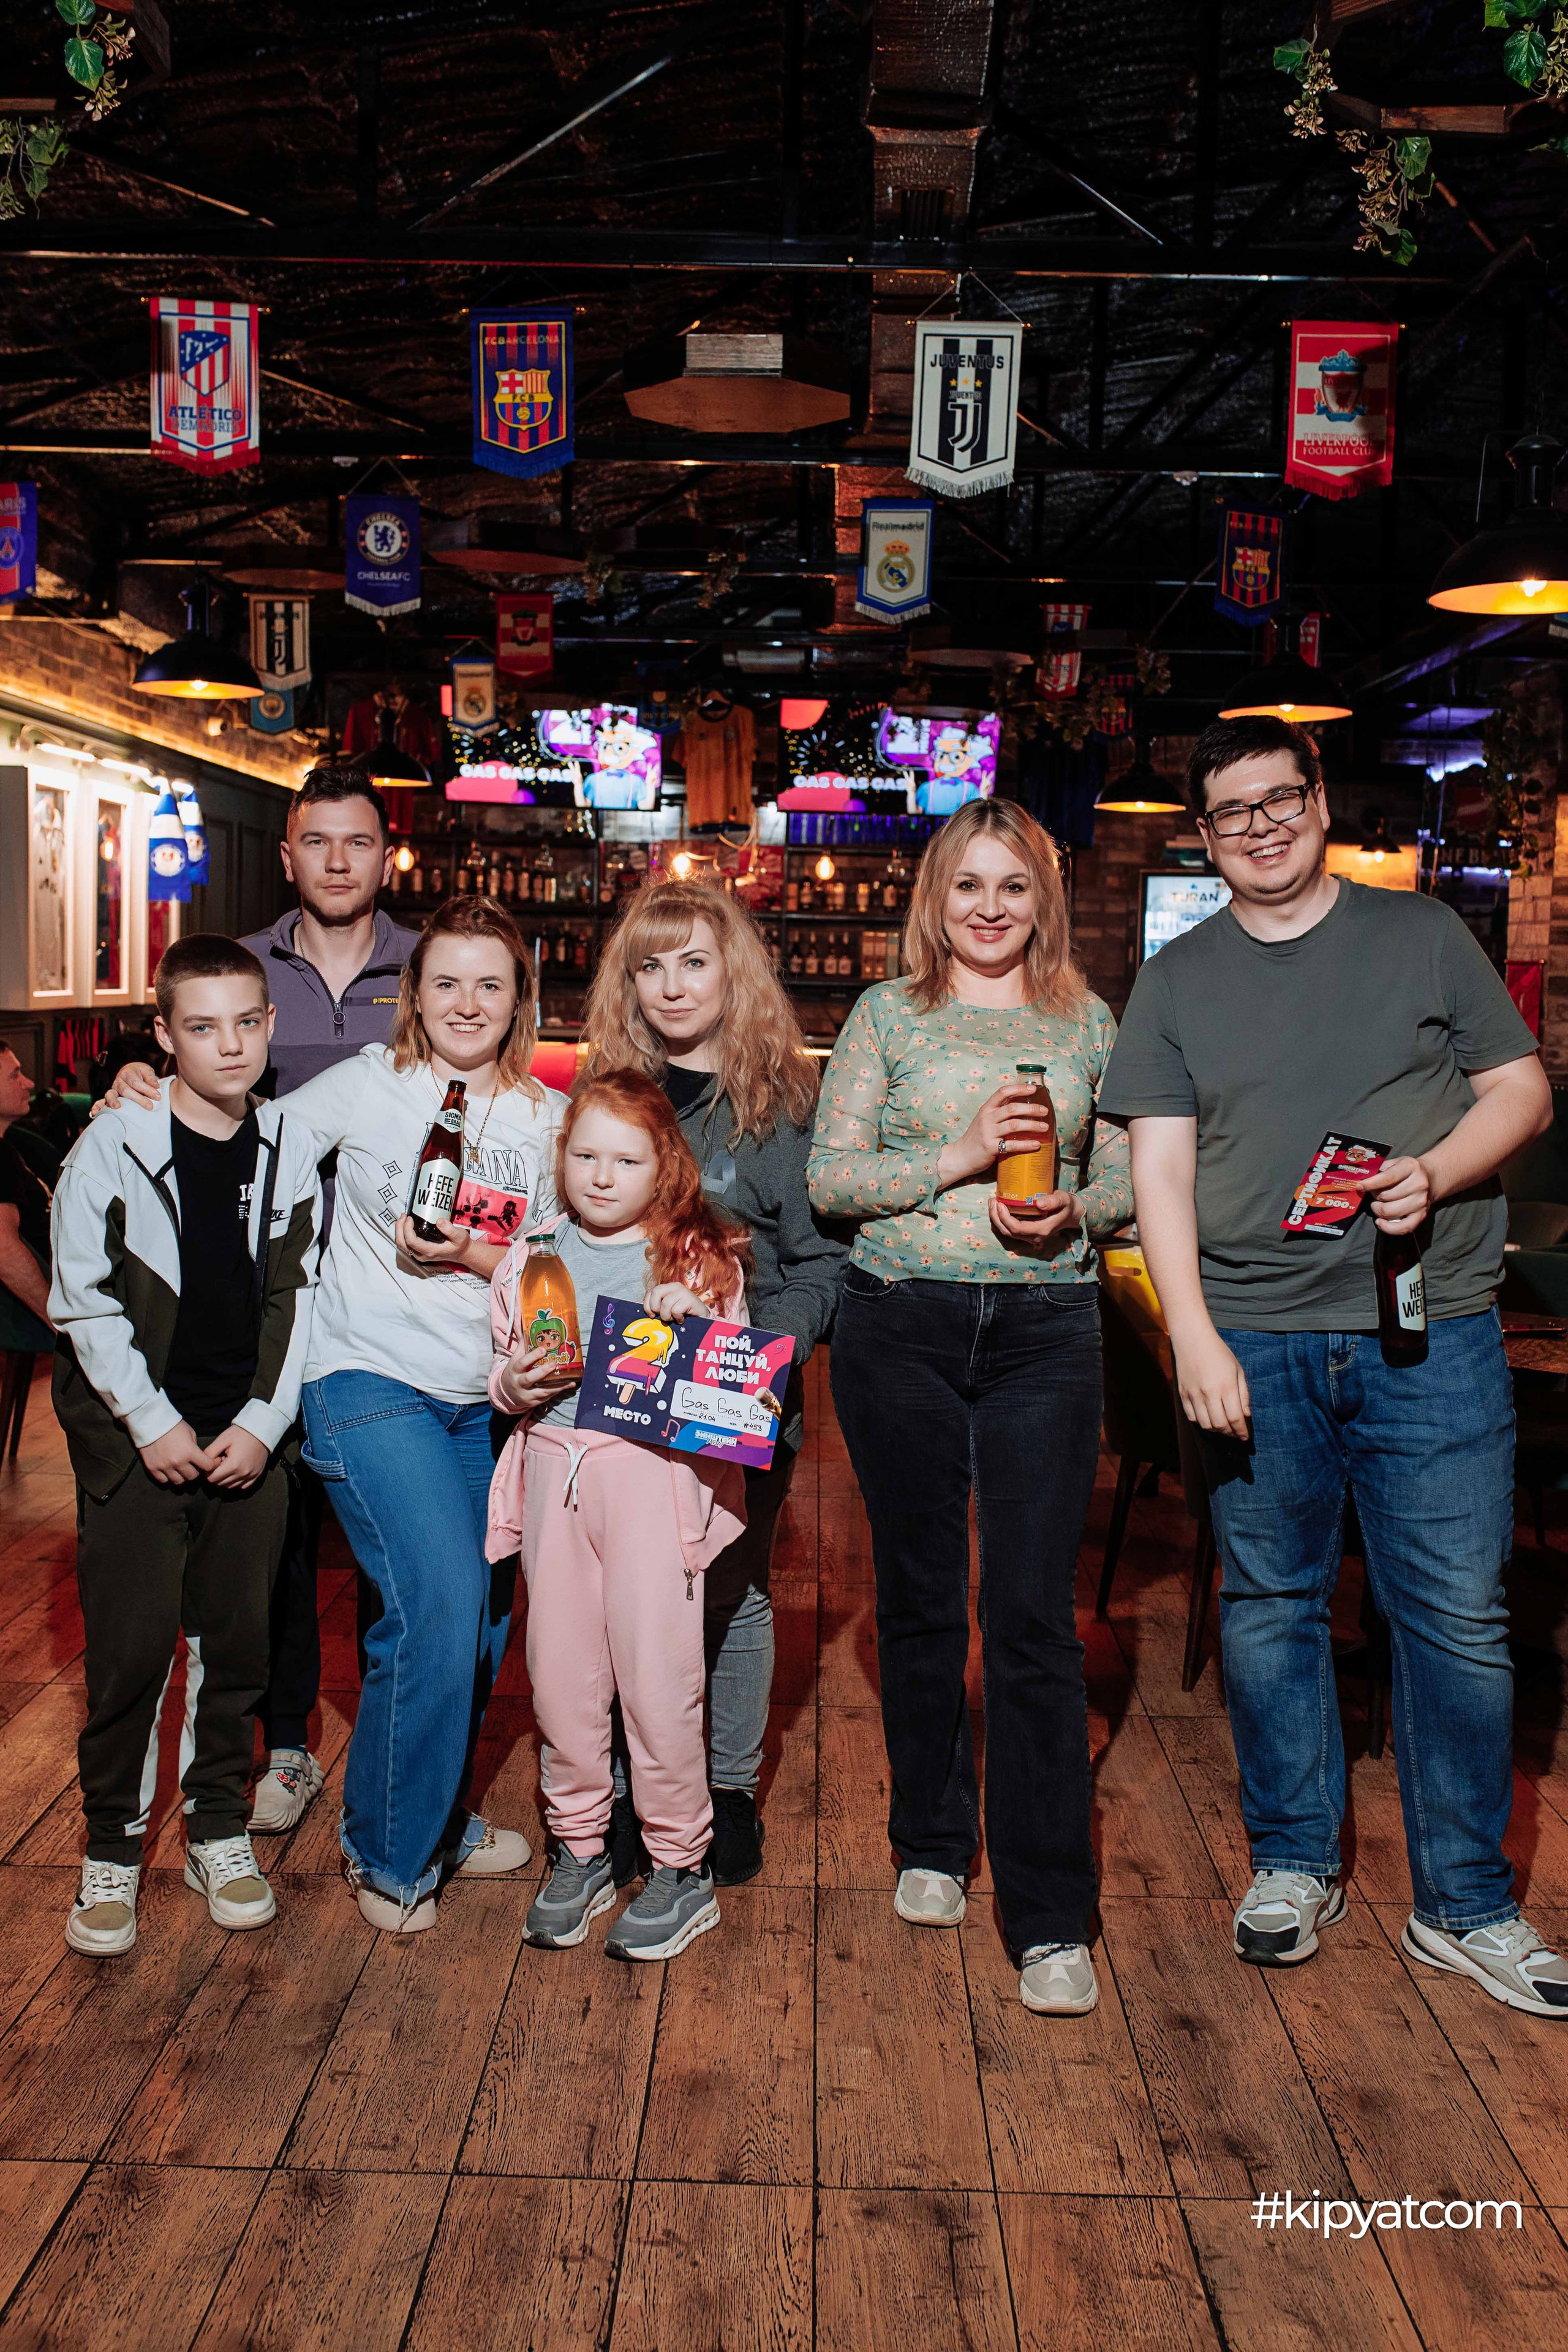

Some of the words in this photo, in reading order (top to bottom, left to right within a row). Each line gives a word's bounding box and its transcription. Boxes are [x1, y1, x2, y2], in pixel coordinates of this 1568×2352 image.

[930, 353, 1005, 369] JUVENTUS
[168, 405, 243, 421] ATLÉTICO
[1303, 446, 1350, 456] FOOTBALL
[445, 1112, 461, 1121] SIGMA
[427, 1172, 454, 1194] HEFE
[1287, 1136, 1342, 1226] СЕРТИФИКАТ
[1325, 1199, 1349, 1208] 000
[714, 1335, 755, 1354] ПОЙ,
[548, 1351, 570, 1365] Fruit
[606, 1317, 679, 1396] 2
[696, 1348, 772, 1372] ТАНЦУЙ,
[704, 1366, 760, 1385] ЛЮБИ
[680, 1386, 709, 1411] Gas
[717, 1397, 742, 1418] Gas
[749, 1404, 772, 1423] Gas
[603, 1404, 652, 1426] МЕСТО
[698, 1412, 716, 1422] 21.04
[743, 1422, 763, 1431] #453
